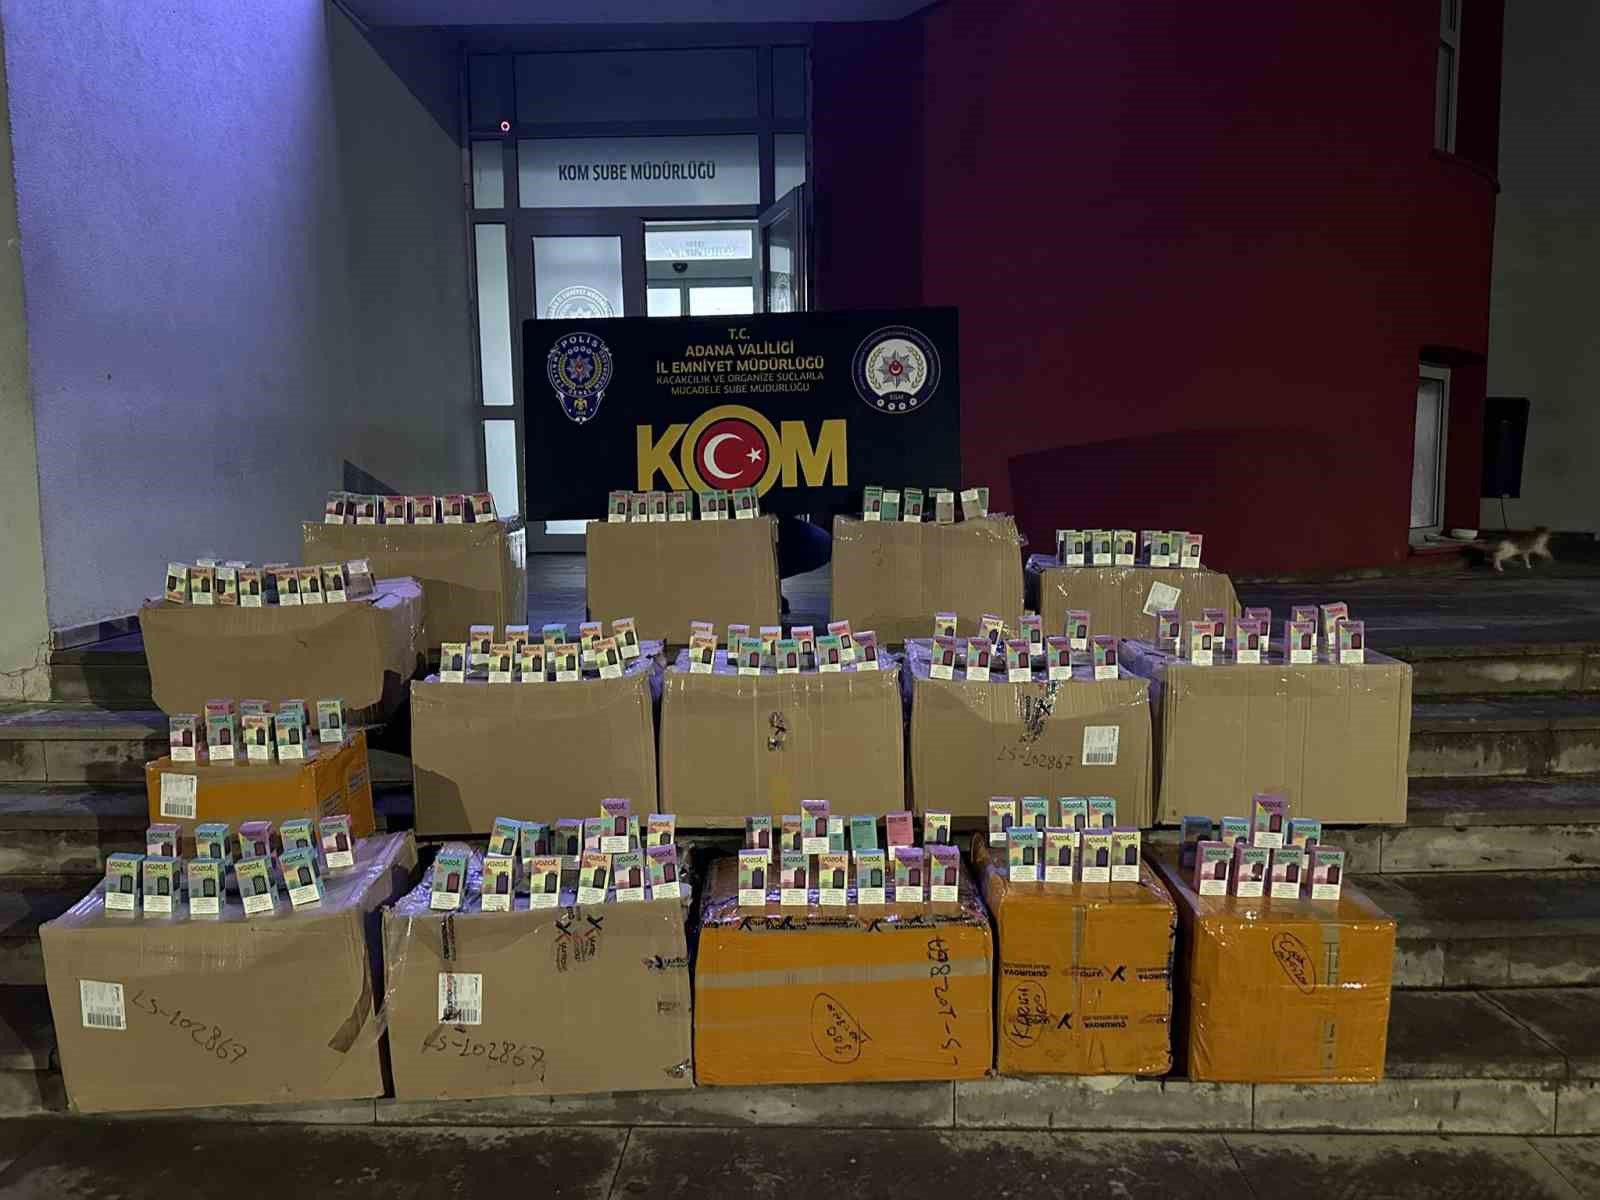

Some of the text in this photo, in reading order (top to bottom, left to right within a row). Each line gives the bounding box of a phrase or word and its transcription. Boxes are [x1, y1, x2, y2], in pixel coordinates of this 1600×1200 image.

[559, 164, 589, 181] KOM
[631, 160, 716, 181] MÜDÜRLÜĞÜ
[728, 327, 751, 341] T.C.
[685, 344, 735, 358] ADANA
[671, 358, 734, 374] EMNİYET
[736, 354, 825, 372] MÜDÜRLÜĞÜ
[637, 404, 848, 498] KOM
